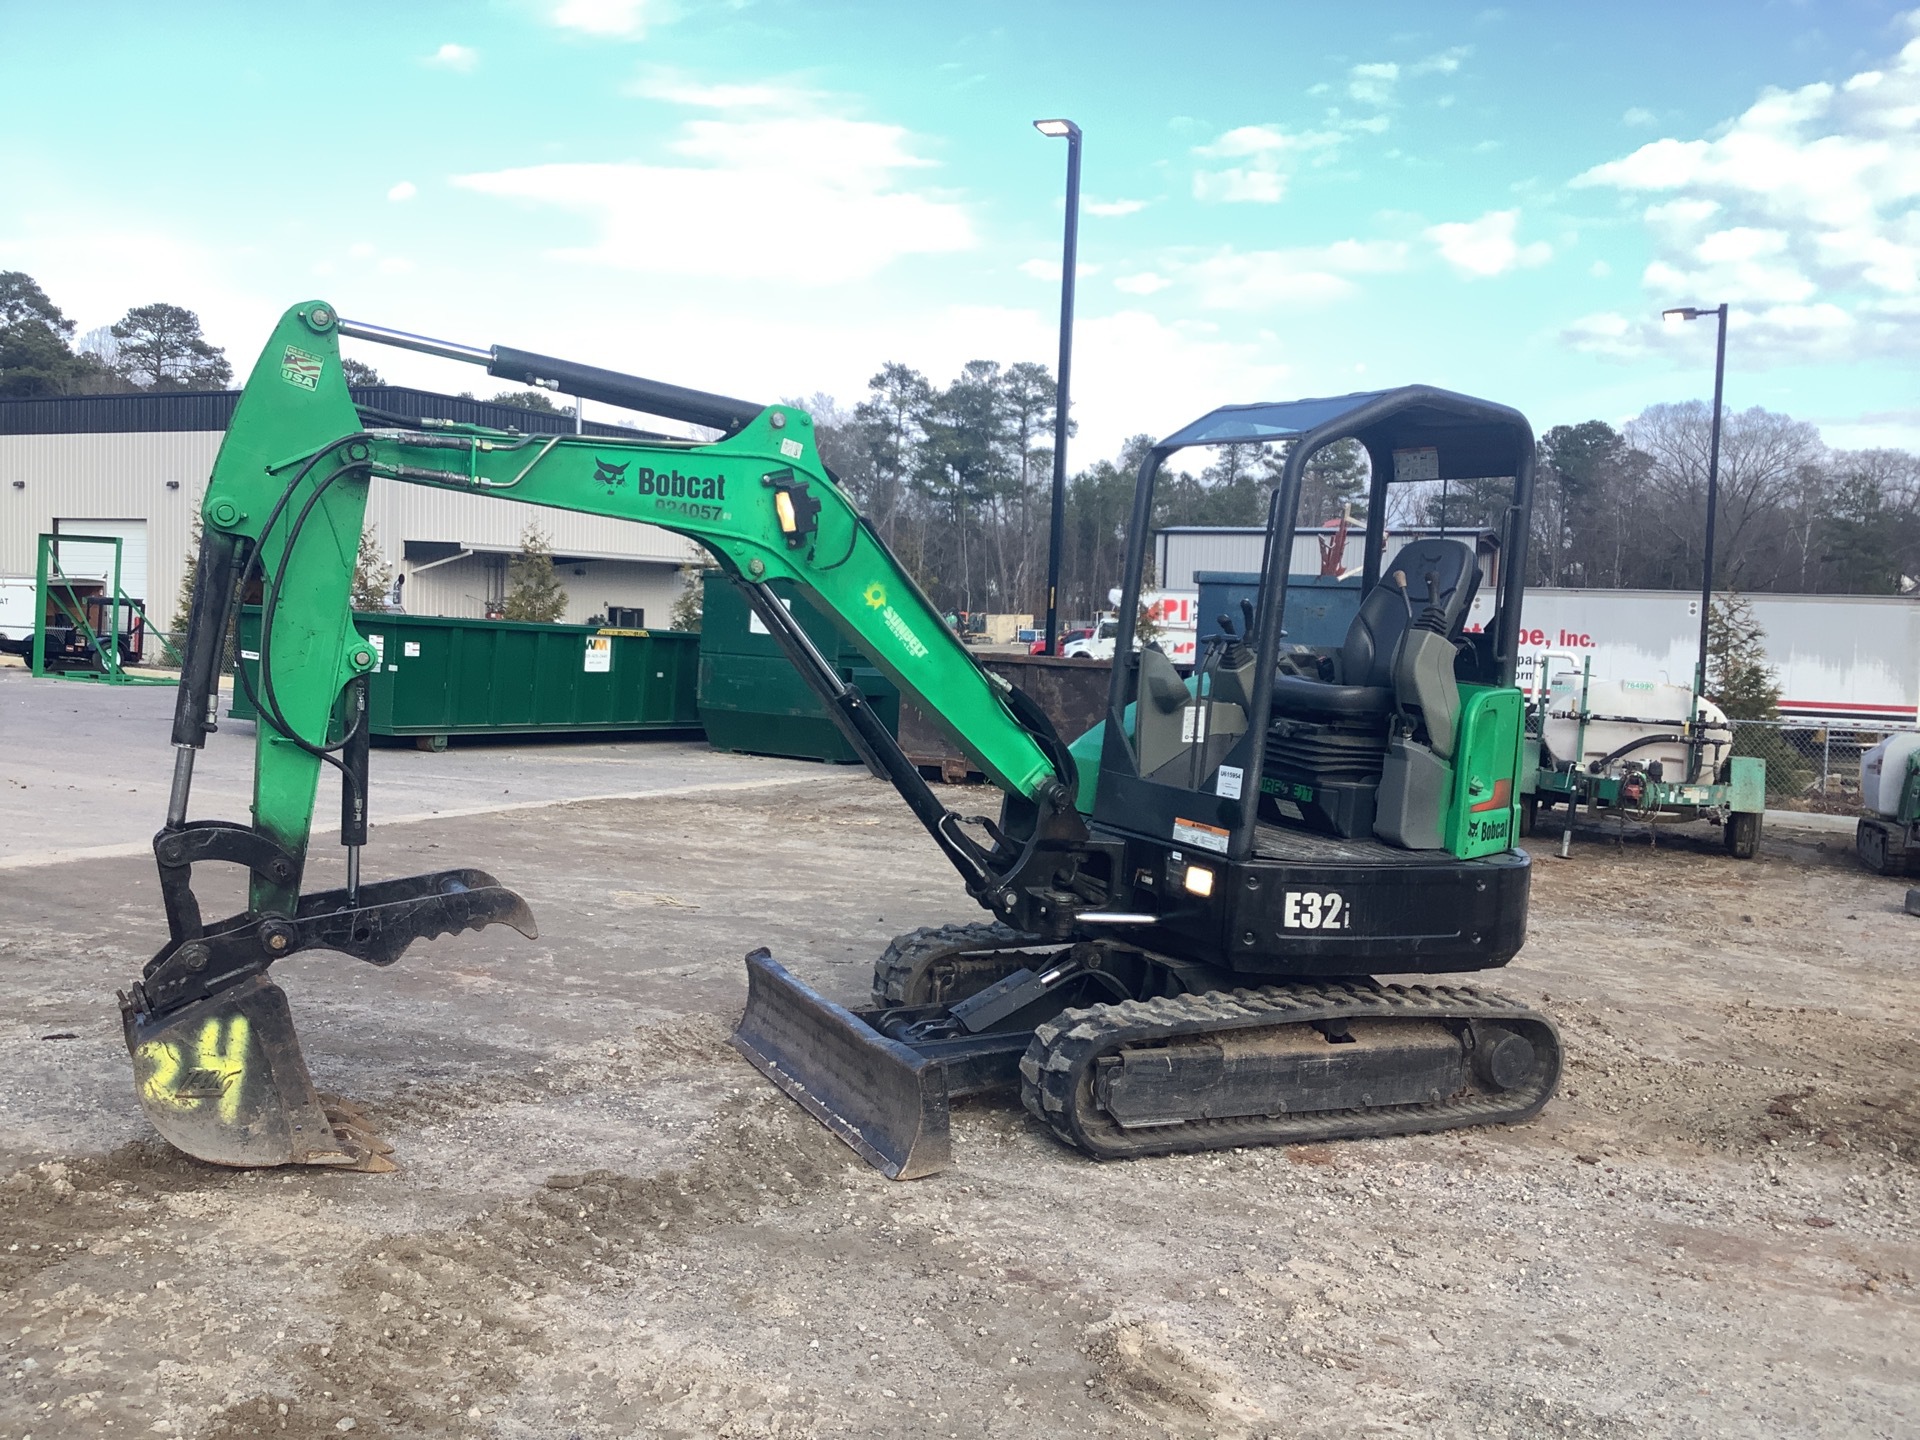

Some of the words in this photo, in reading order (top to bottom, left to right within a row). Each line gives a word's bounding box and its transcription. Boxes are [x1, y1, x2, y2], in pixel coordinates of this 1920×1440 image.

[281, 369, 313, 387] USA
[639, 467, 725, 501] Bobcat
[883, 606, 929, 658] SUNBELT
[1560, 629, 1596, 648] Inc.
[585, 640, 608, 650] WM
[1481, 820, 1508, 842] Bobcat
